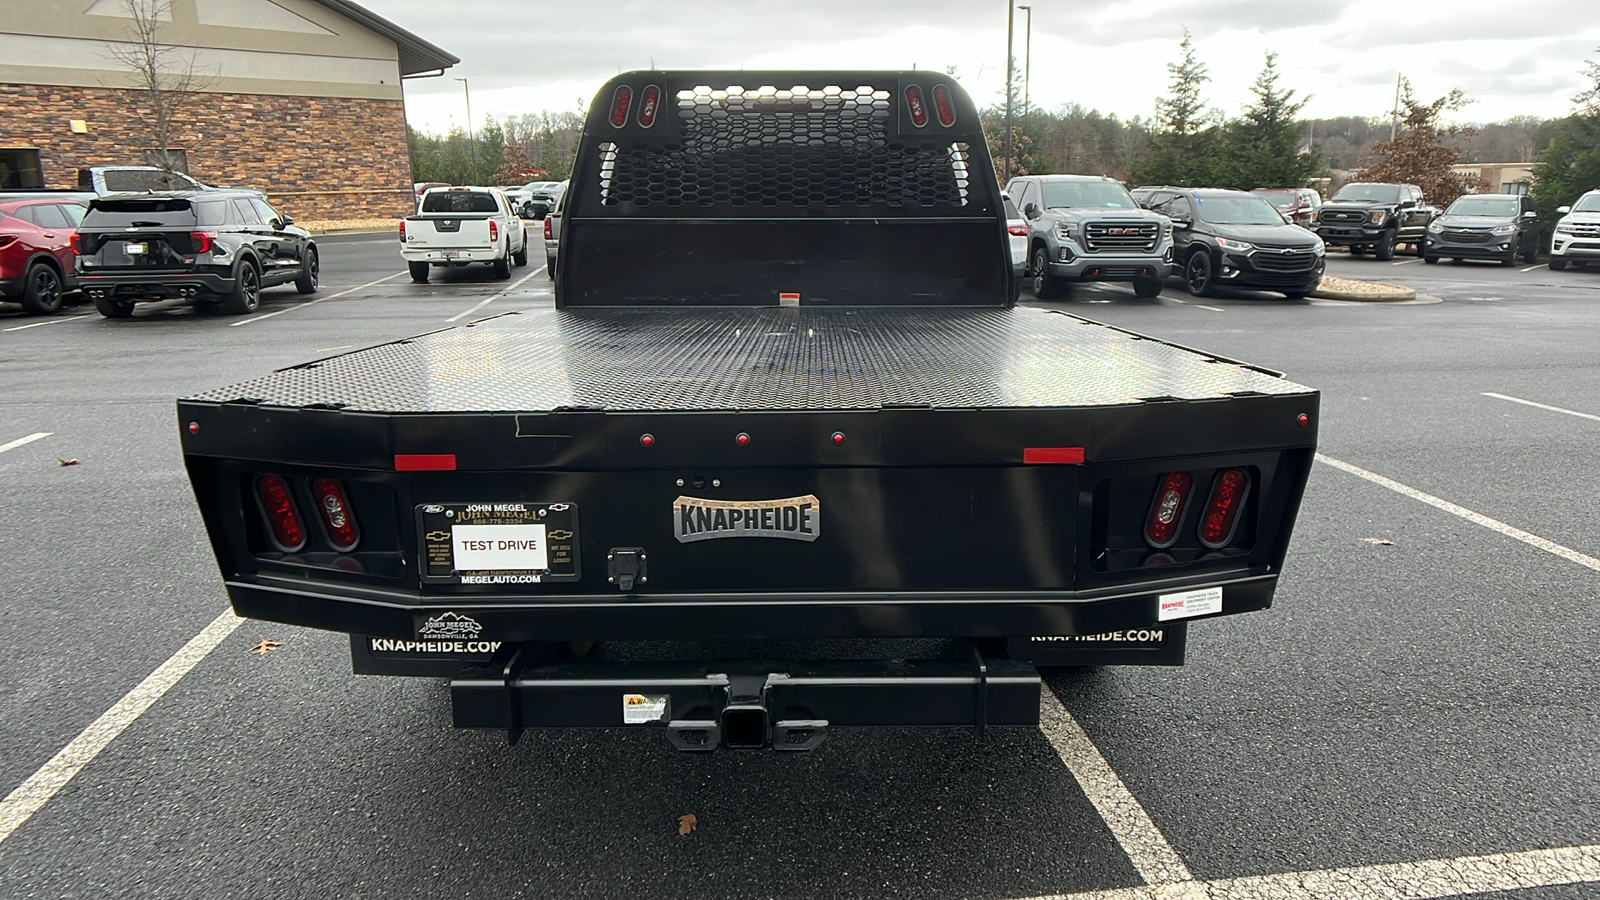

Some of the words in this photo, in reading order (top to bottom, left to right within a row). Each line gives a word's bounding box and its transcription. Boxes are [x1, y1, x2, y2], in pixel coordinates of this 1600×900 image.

[465, 504, 491, 512] JOHN
[494, 504, 527, 512] MEGEL
[681, 503, 812, 535] KNAPHEIDE
[461, 540, 494, 551] TEST
[498, 540, 537, 551] DRIVE
[461, 575, 541, 584] MEGELAUTO.COM
[425, 621, 445, 630] JOHN
[446, 621, 475, 629] MEGEL
